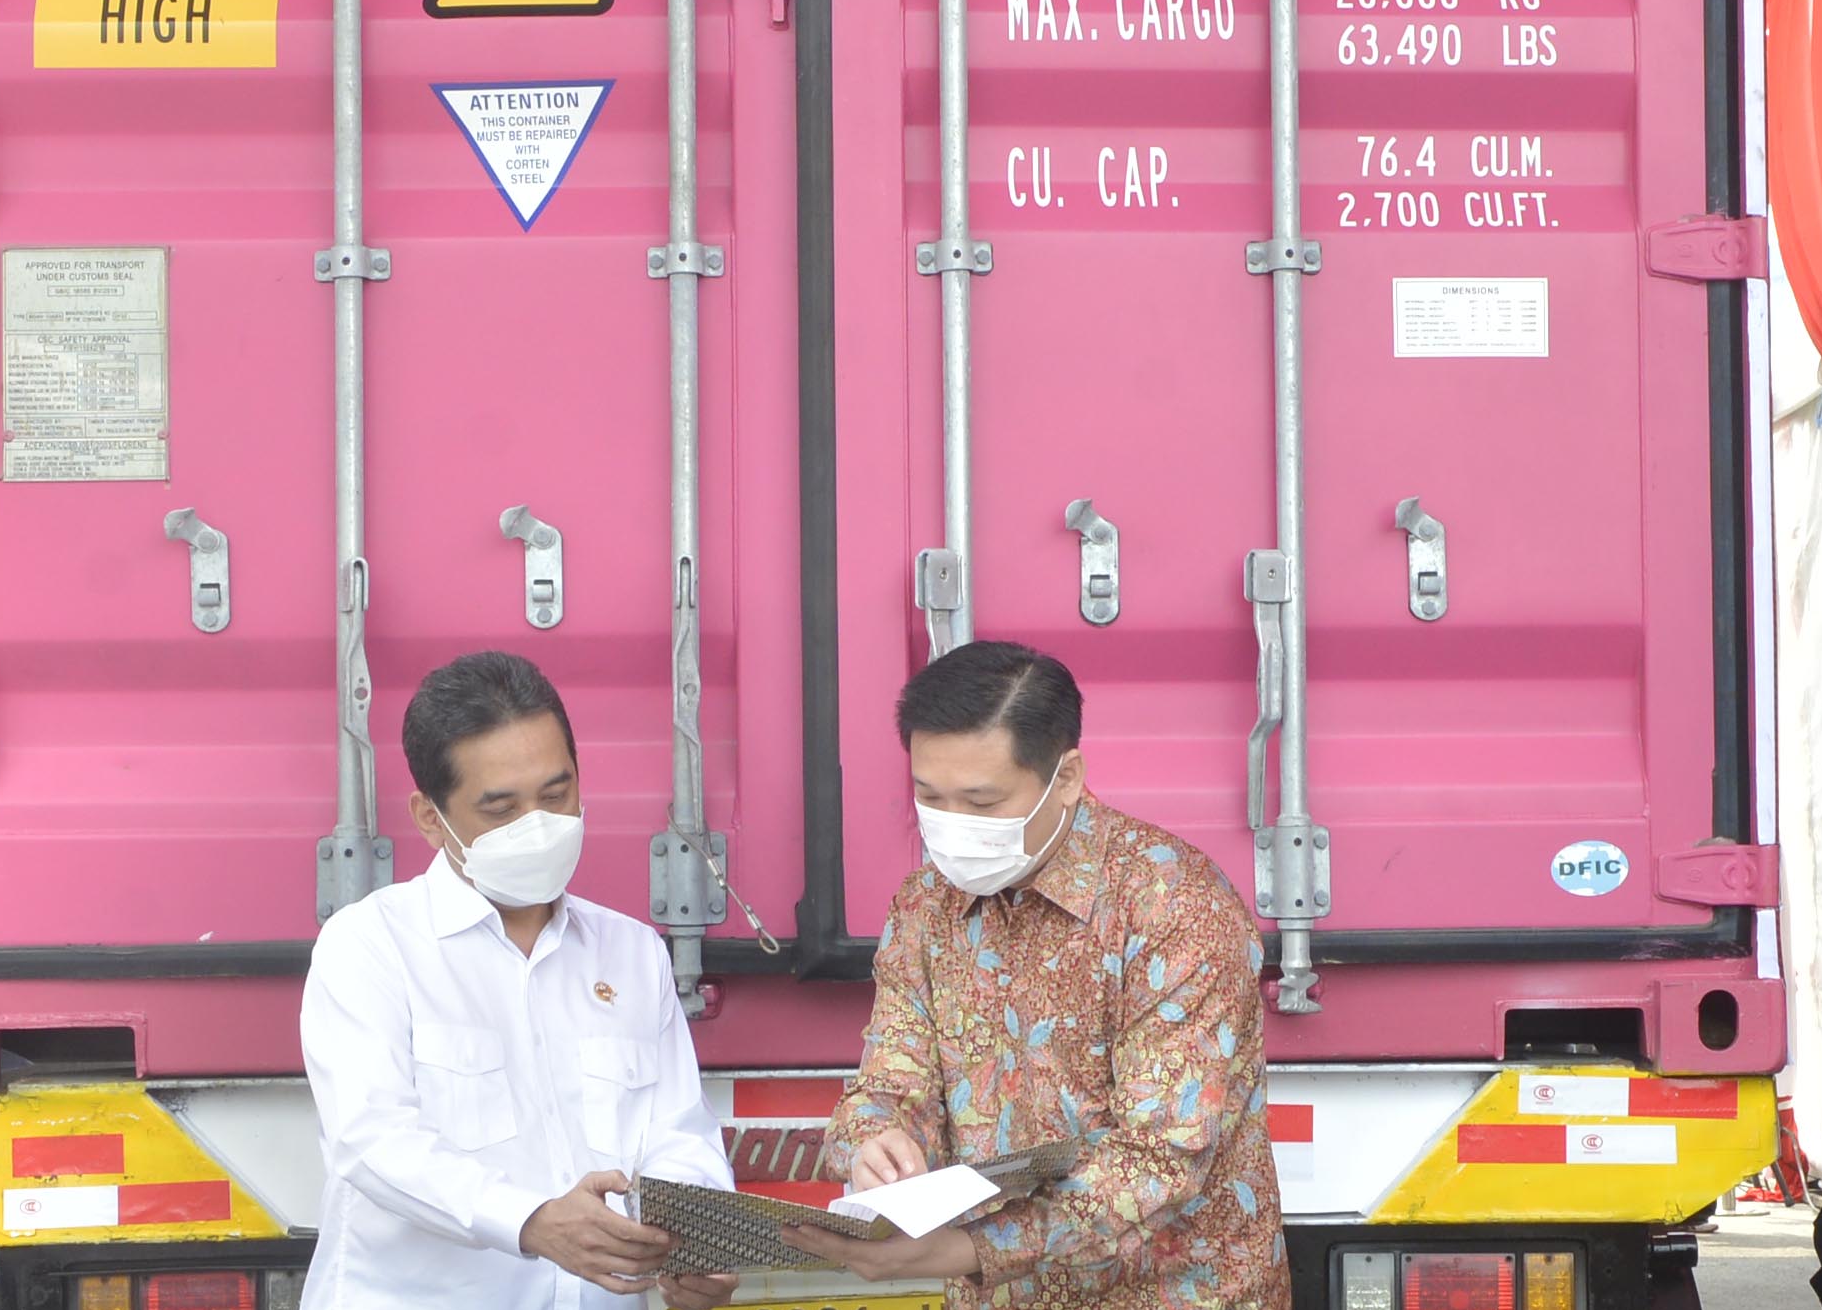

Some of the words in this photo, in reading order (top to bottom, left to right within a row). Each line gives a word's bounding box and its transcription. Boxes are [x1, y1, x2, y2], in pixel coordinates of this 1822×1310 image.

[1502, 23, 1559, 67] LBS
[470, 92, 580, 111] ATTENTION
[481, 117, 506, 128] THIS
[508, 115, 571, 127] CONTAINER
[476, 131, 507, 142] MUST
[509, 130, 523, 141] BE
[525, 129, 578, 141] REPAIRED
[514, 145, 540, 155] WITH
[1356, 135, 1437, 178] 76.4
[1470, 135, 1554, 178] CU.M.
[505, 159, 550, 170] CORTEN
[510, 173, 546, 185] STEEL
[1007, 146, 1064, 208] CU.
[1097, 146, 1179, 208] CAP.
[1464, 191, 1559, 228] CU.FT.
[25, 262, 71, 270] APPROVED
[73, 261, 92, 270] FOR
[95, 260, 146, 270] TRANSPORT
[36, 272, 66, 281] UNDER
[68, 272, 110, 281] CUSTOMS
[113, 272, 135, 281] SEAL
[1442, 286, 1500, 295] DIMENSIONS
[1559, 859, 1622, 877] DFIC
